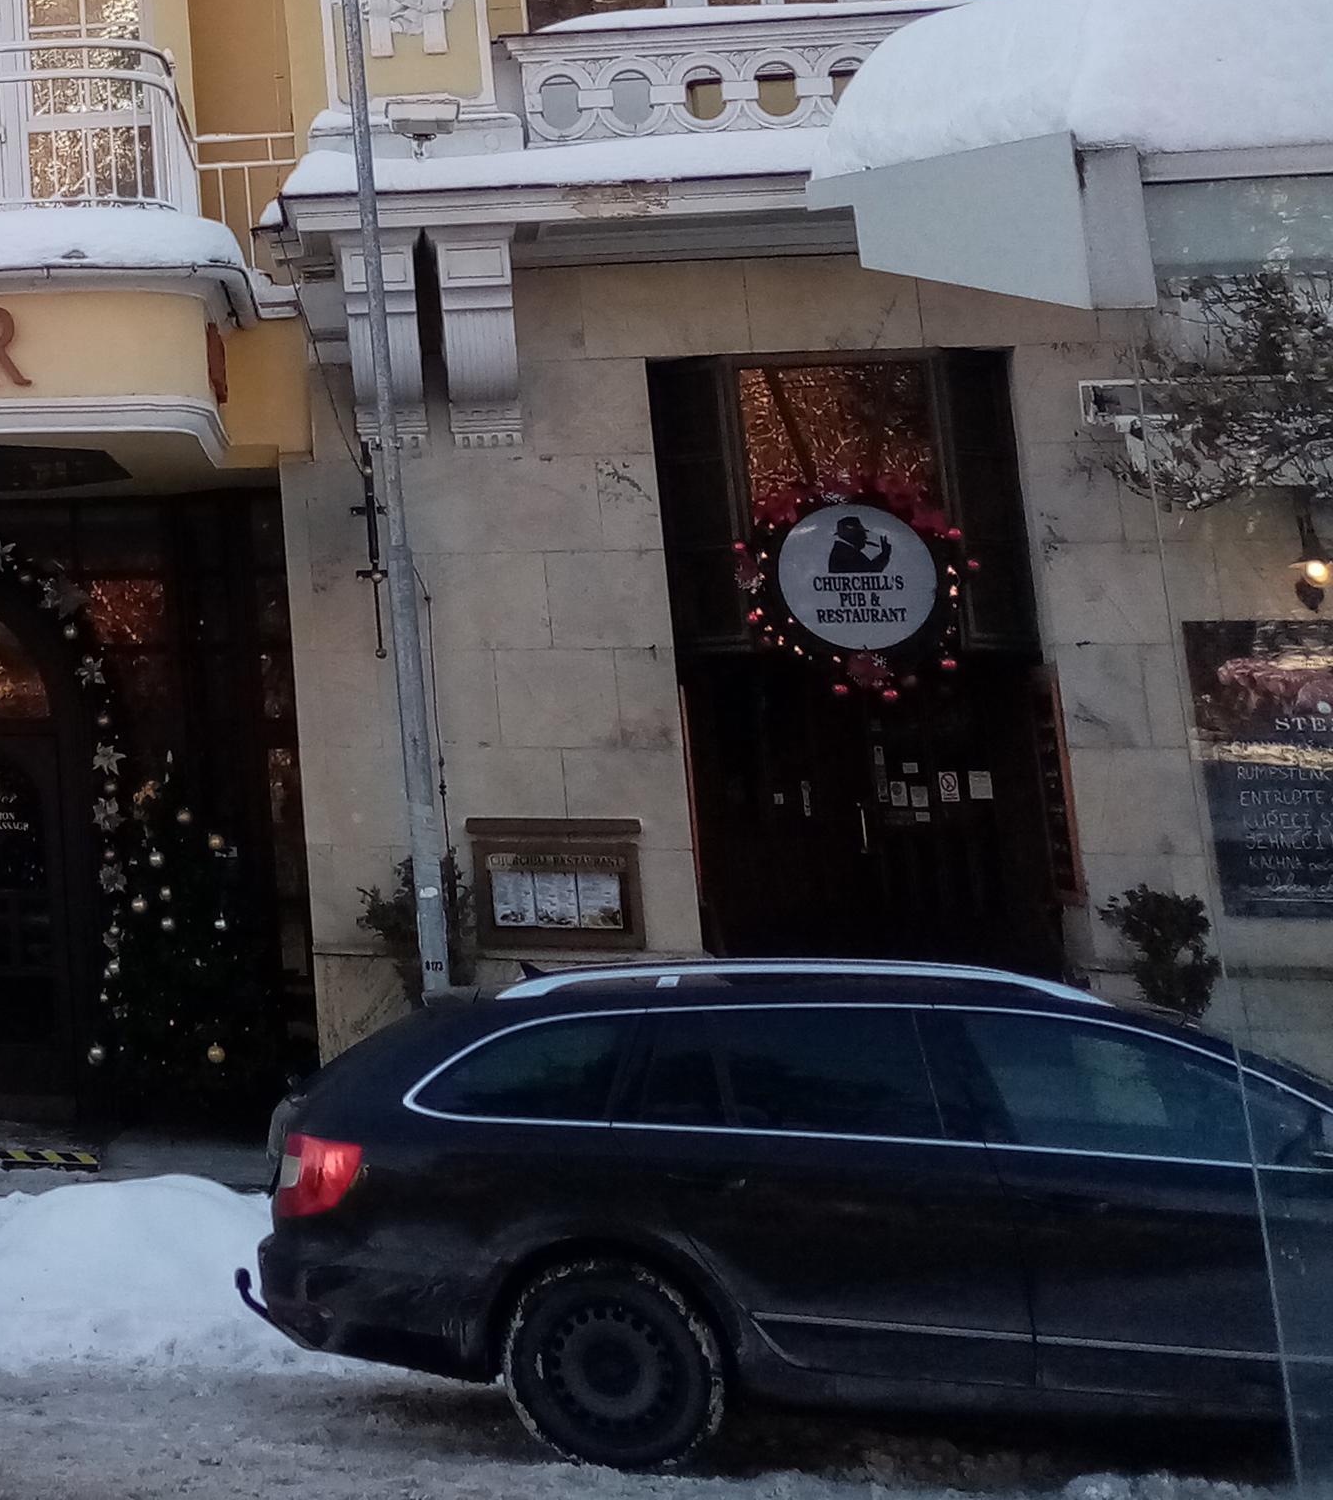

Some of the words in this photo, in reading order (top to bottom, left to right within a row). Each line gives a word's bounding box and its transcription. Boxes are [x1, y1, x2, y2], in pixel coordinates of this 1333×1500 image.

[813, 575, 905, 591] CHURCHILL'S
[839, 592, 866, 607] PUB
[870, 592, 881, 606] &
[816, 607, 907, 624] RESTAURANT
[1275, 716, 1333, 732] STE
